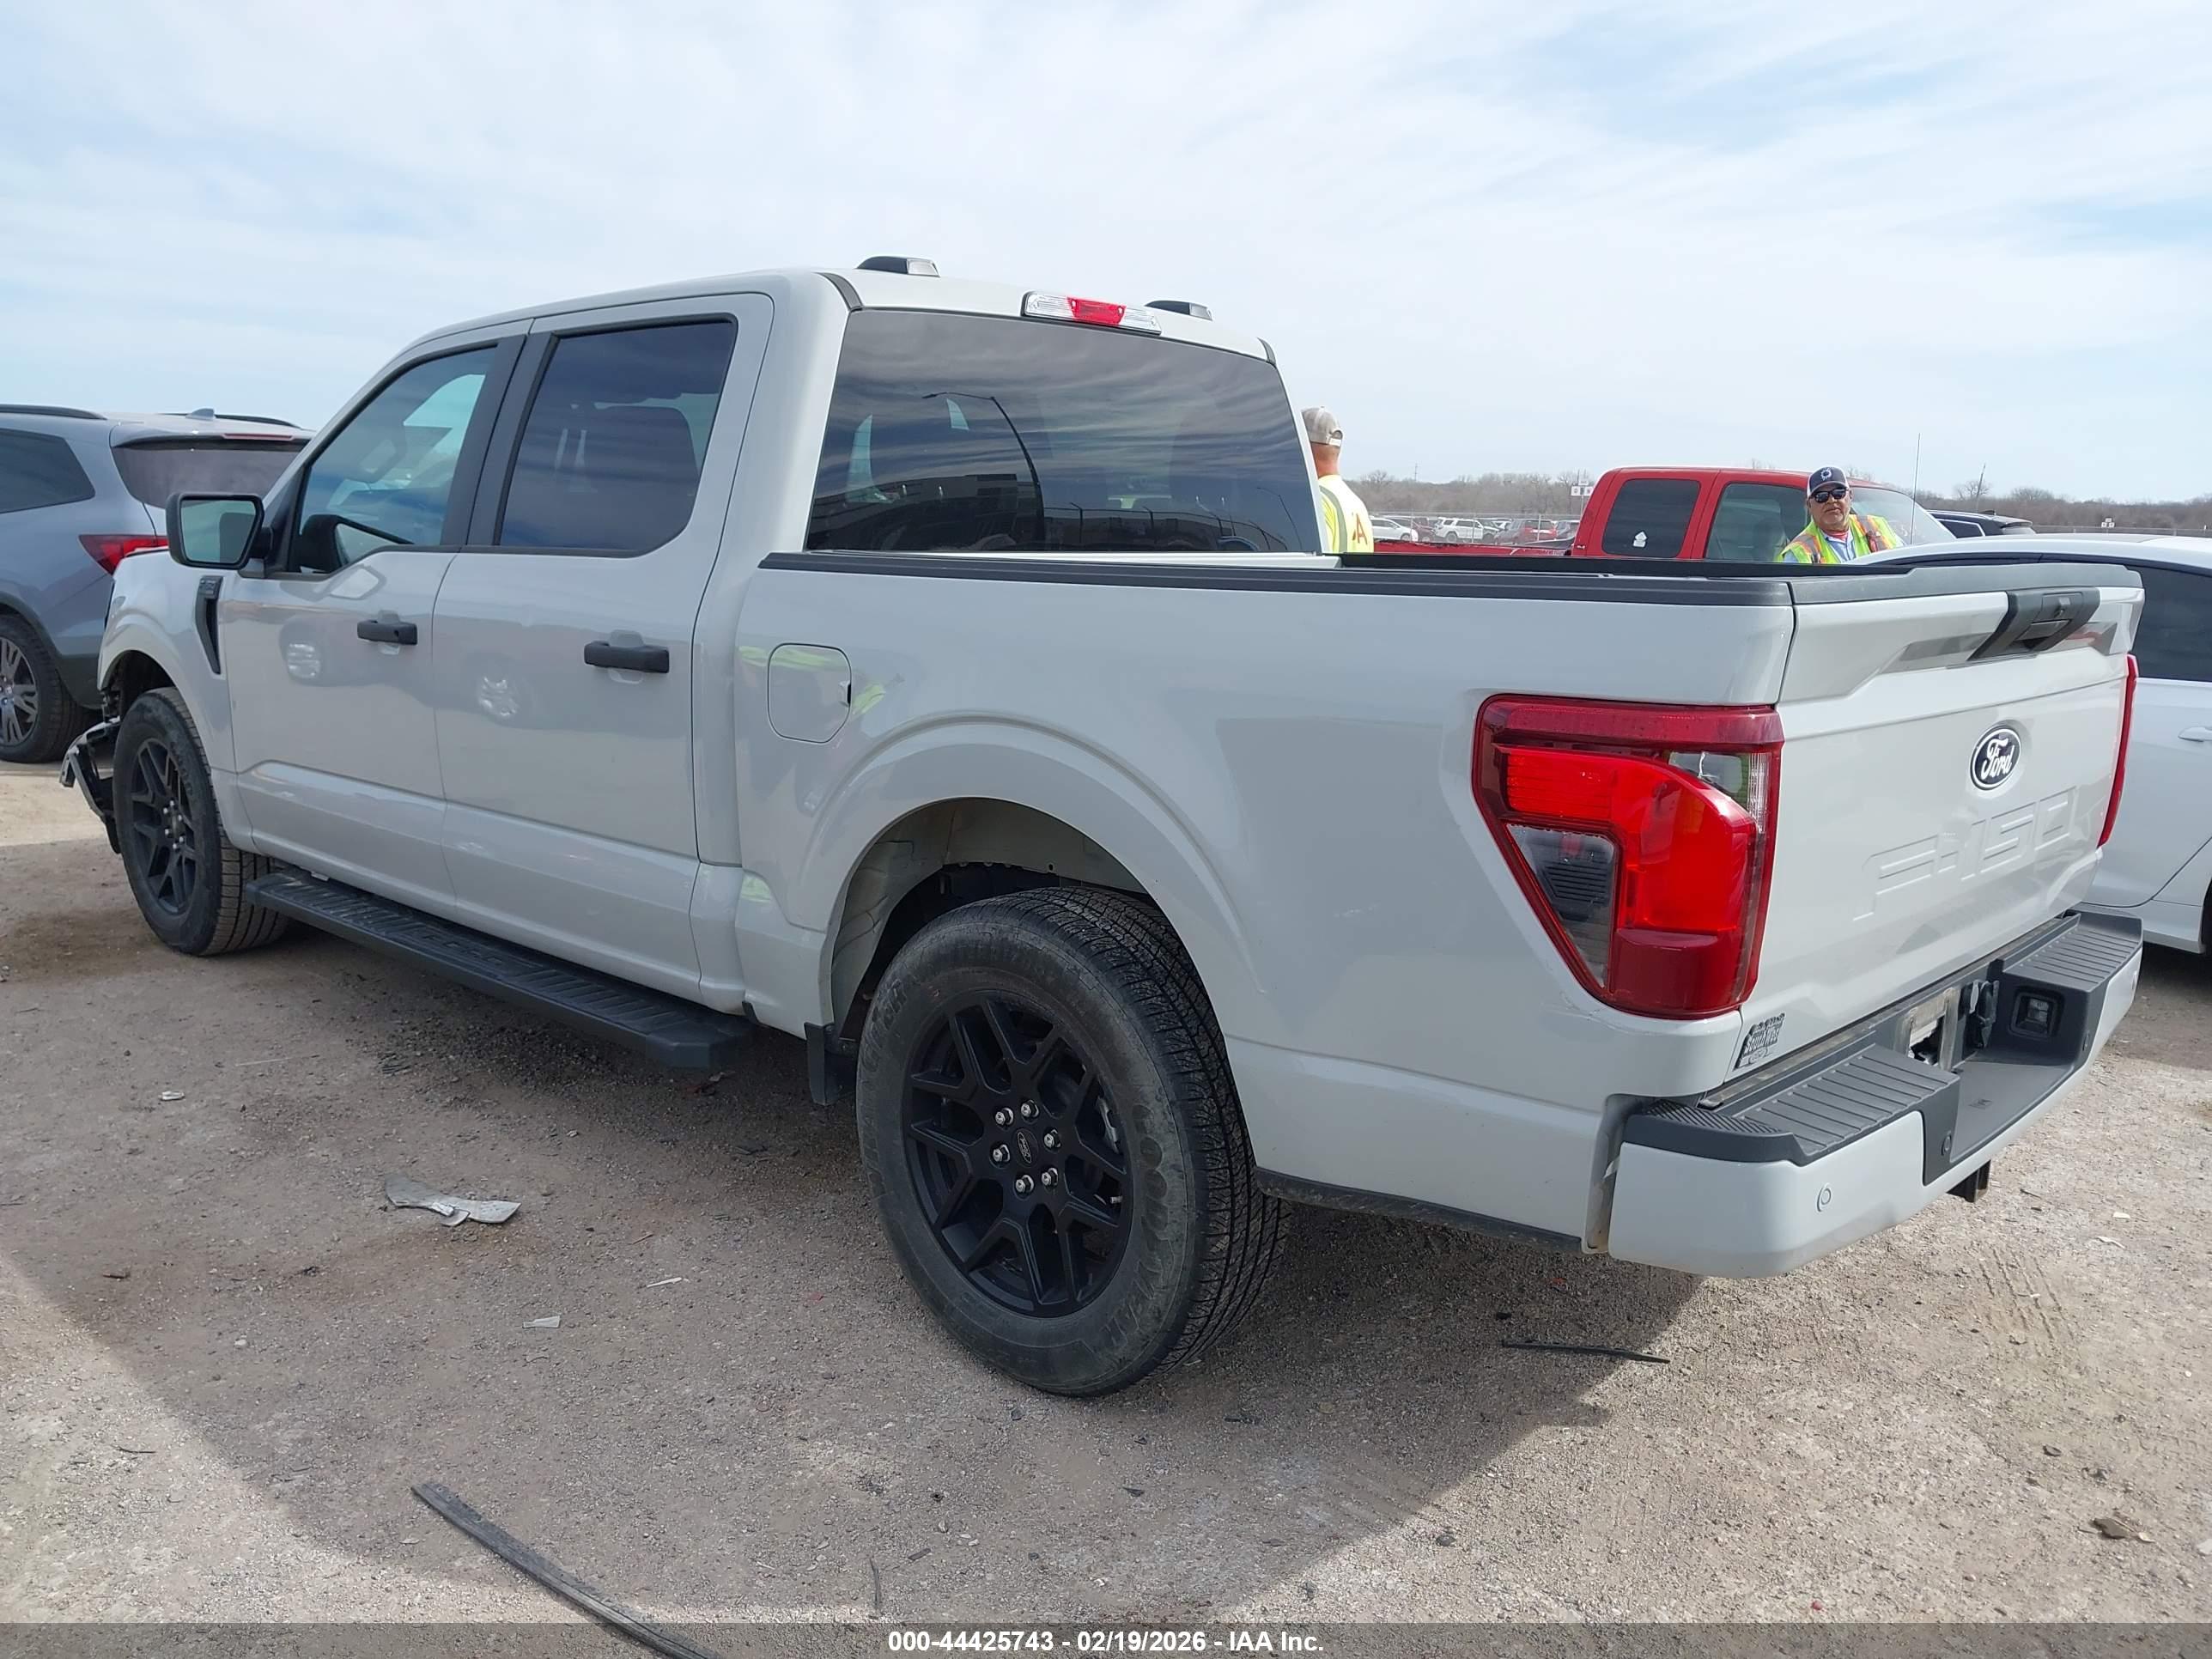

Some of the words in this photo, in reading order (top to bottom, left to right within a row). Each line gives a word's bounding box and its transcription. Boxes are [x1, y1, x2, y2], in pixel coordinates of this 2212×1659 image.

[1981, 738, 2014, 780] Ford
[1852, 785, 2077, 921] F-150
[1100, 1104, 1174, 1349] GOODYEAR
